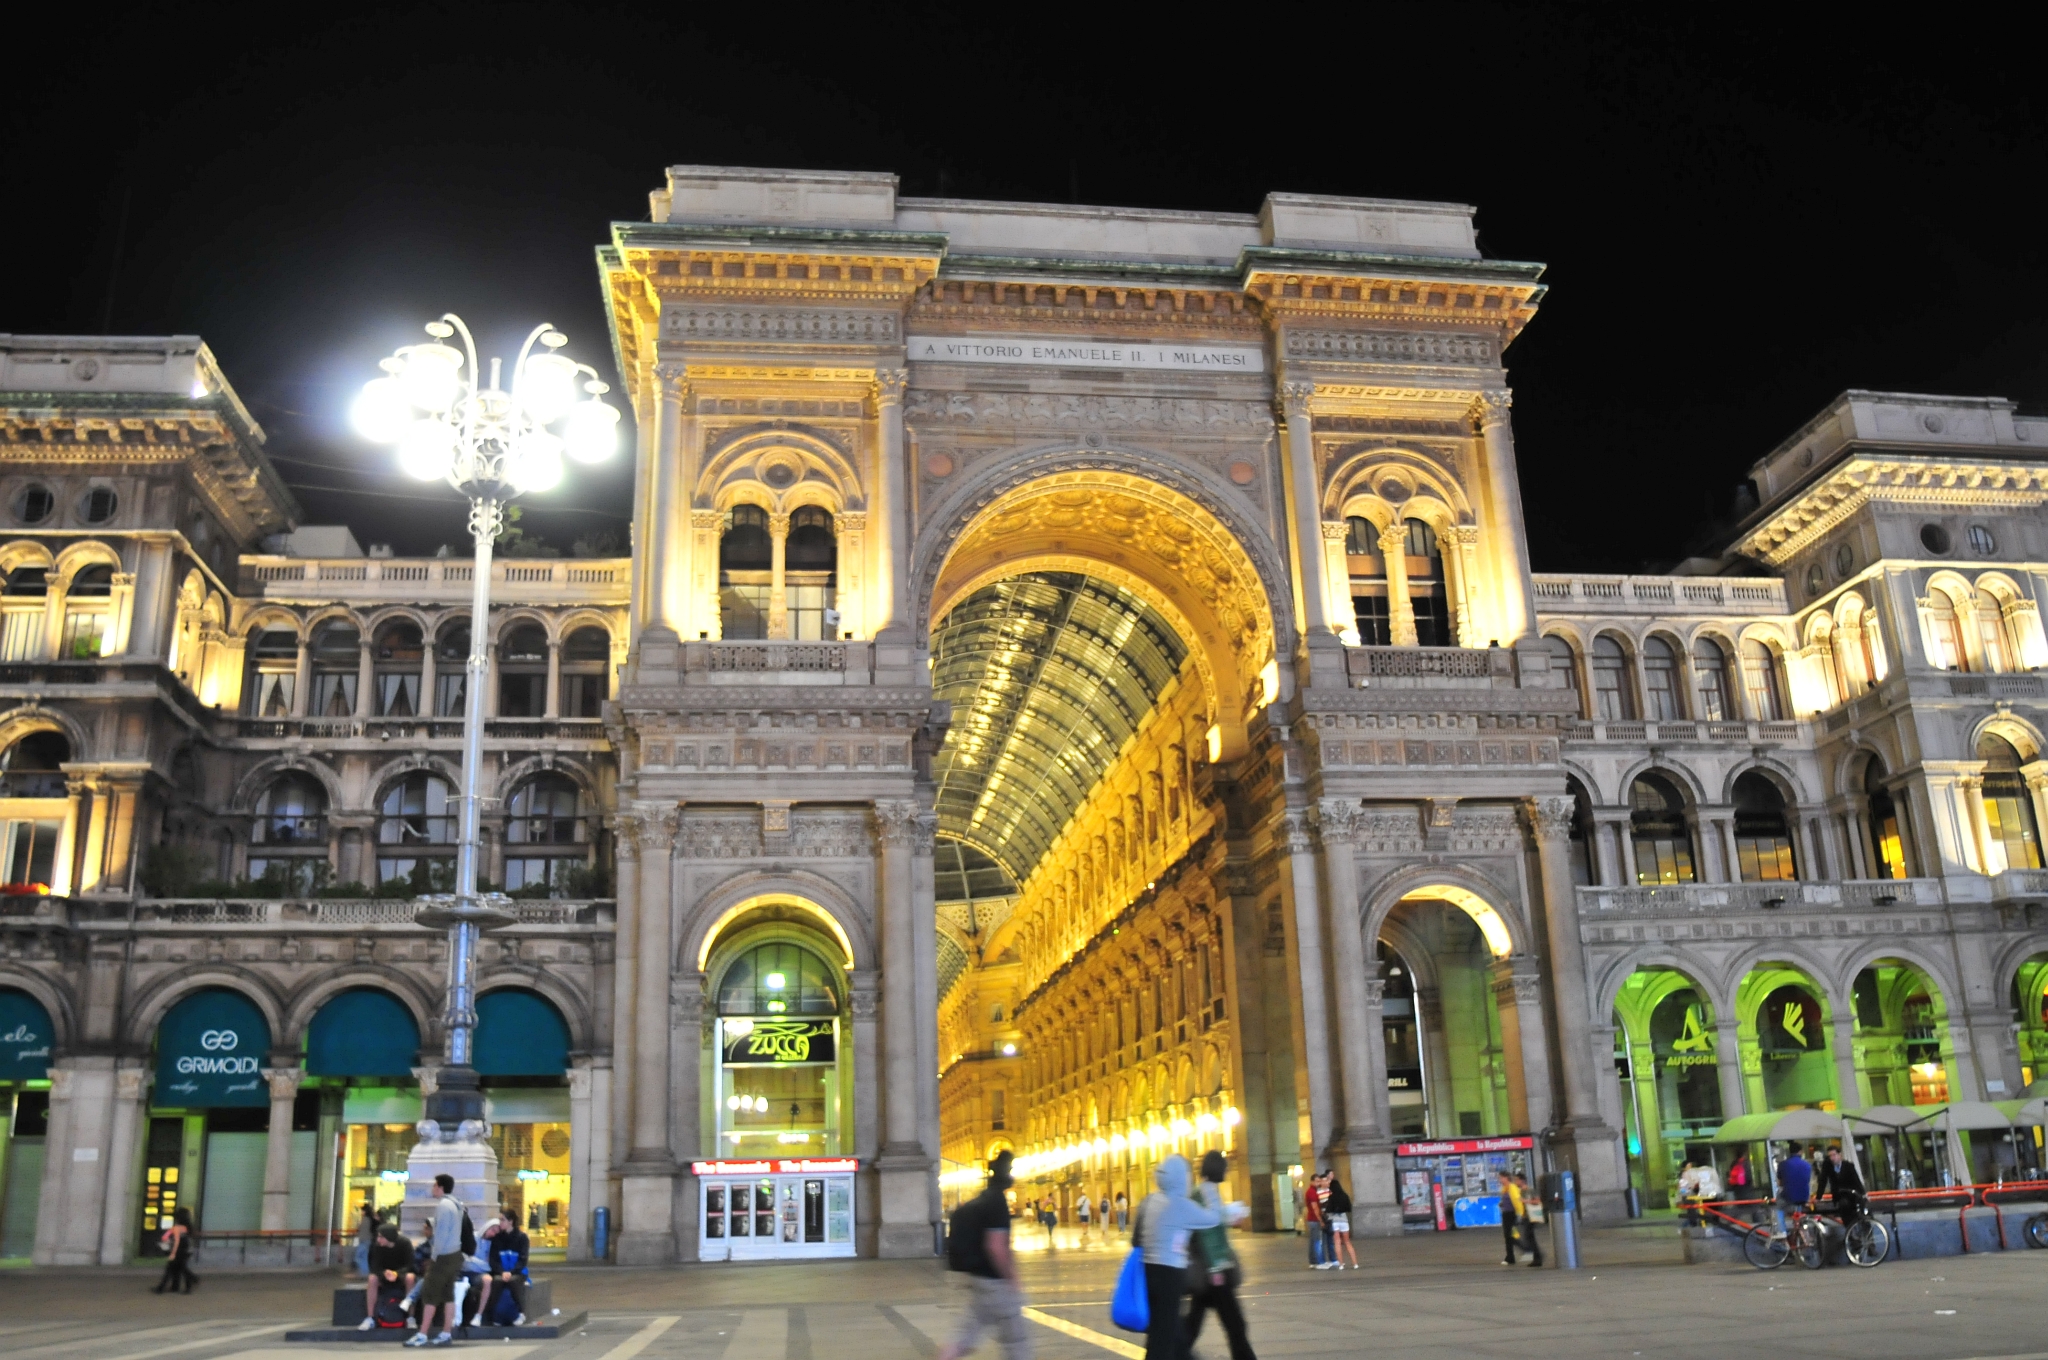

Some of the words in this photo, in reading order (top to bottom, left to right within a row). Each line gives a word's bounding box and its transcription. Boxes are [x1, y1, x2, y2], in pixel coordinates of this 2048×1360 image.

[925, 344, 936, 354] A
[946, 344, 1023, 357] VITTORIO
[1033, 347, 1122, 360] EMANUELE
[1174, 352, 1246, 366] MILANESI
[748, 1035, 810, 1060] ZUCCA
[177, 1056, 258, 1074] GRIMOLDI
[1417, 1142, 1454, 1153] Repubblica
[1485, 1139, 1521, 1149] Repubblica
